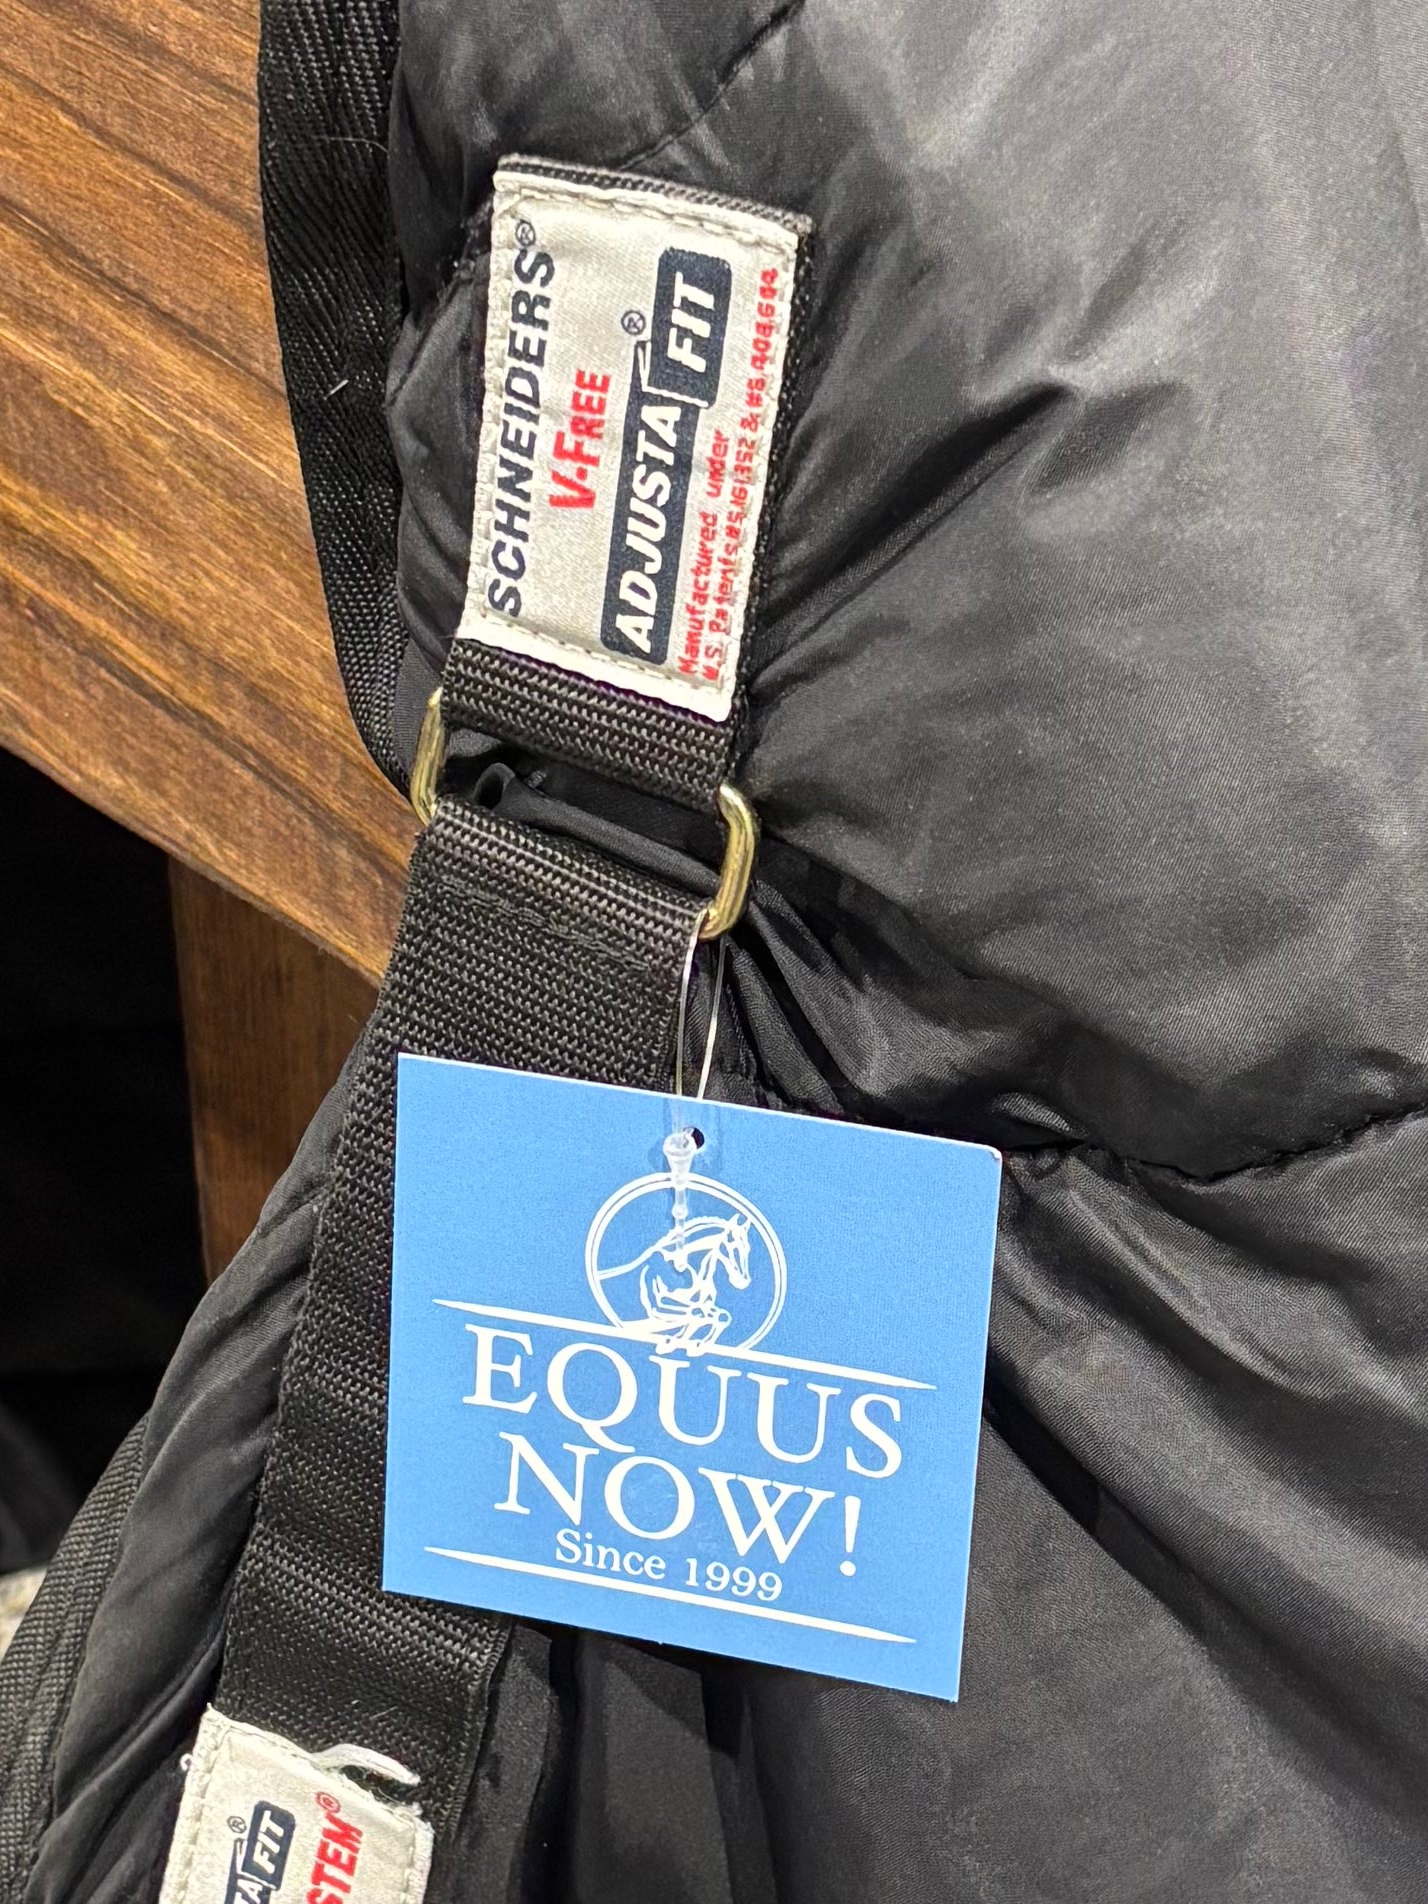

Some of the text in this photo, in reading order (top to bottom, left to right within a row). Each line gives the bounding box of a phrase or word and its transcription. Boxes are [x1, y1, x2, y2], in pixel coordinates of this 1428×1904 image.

[615, 405, 682, 654] ADJUSTA
[678, 430, 729, 674] Manufactured under
[708, 544, 740, 634] Patents
[462, 1323, 903, 1479] EQUUS
[493, 1431, 862, 1577] NOW!
[555, 1527, 783, 1601] Since 1999
